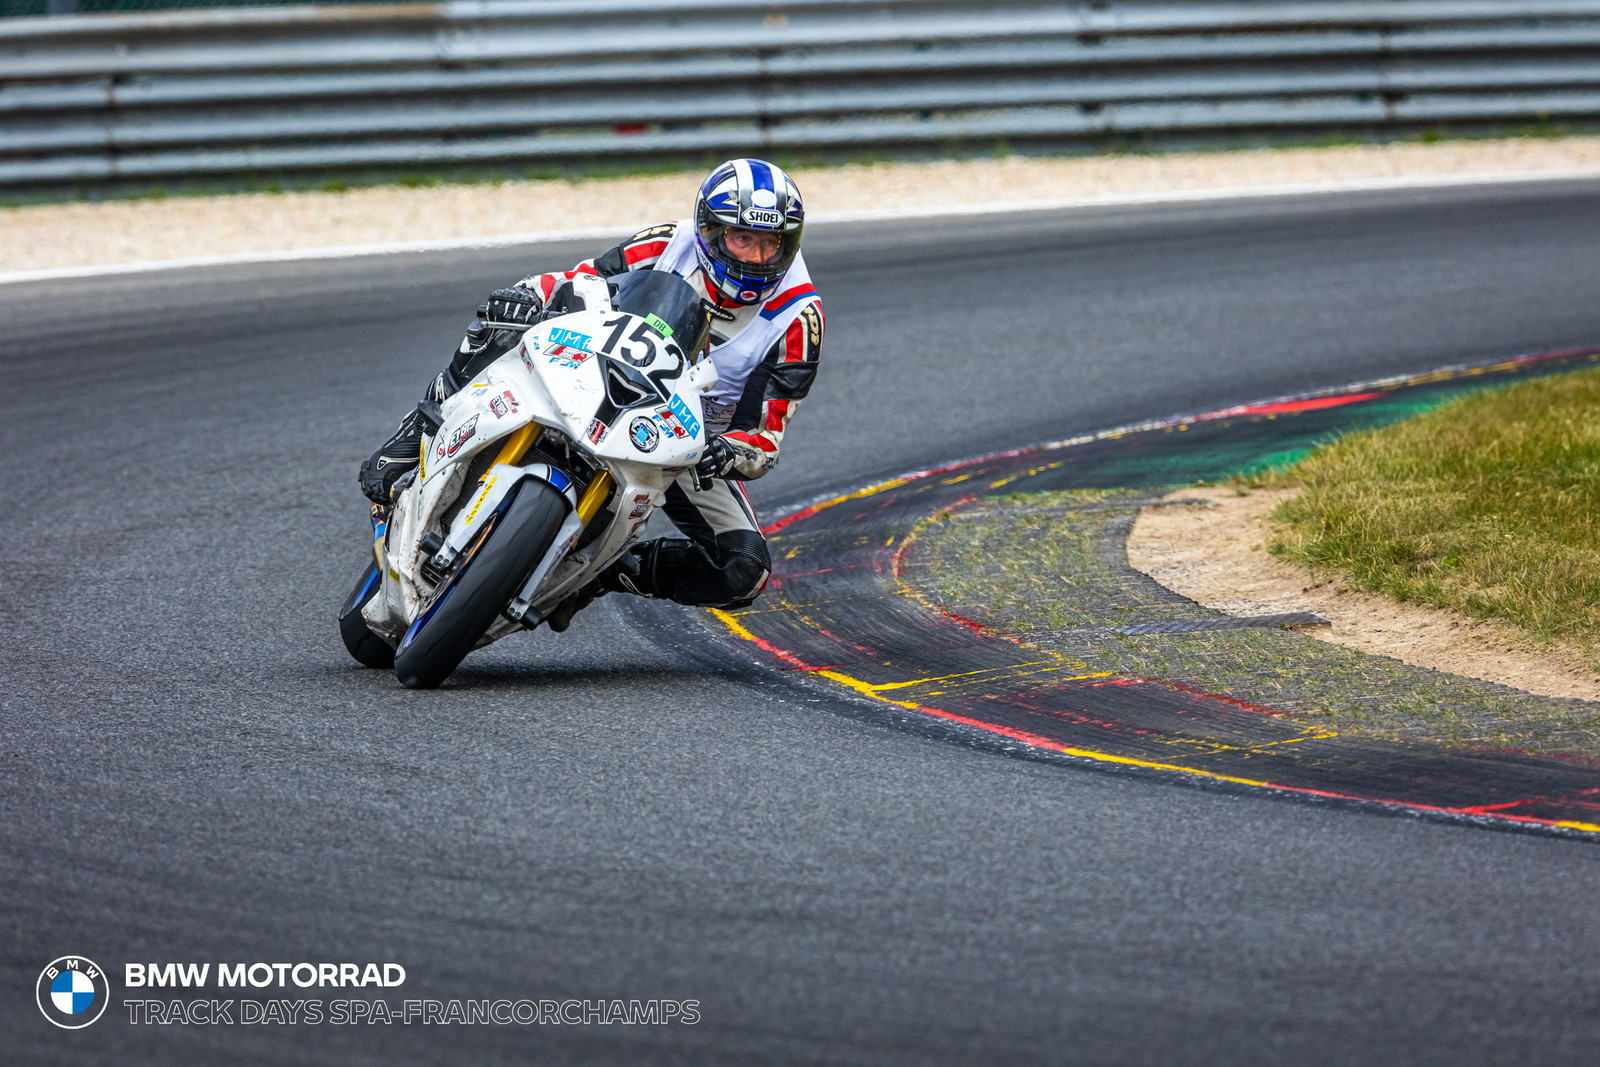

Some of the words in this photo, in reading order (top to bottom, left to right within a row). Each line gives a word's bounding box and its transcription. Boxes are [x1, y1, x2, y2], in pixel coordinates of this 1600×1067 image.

[748, 210, 779, 224] SHOEI
[652, 319, 667, 332] DB
[601, 314, 685, 402] 152
